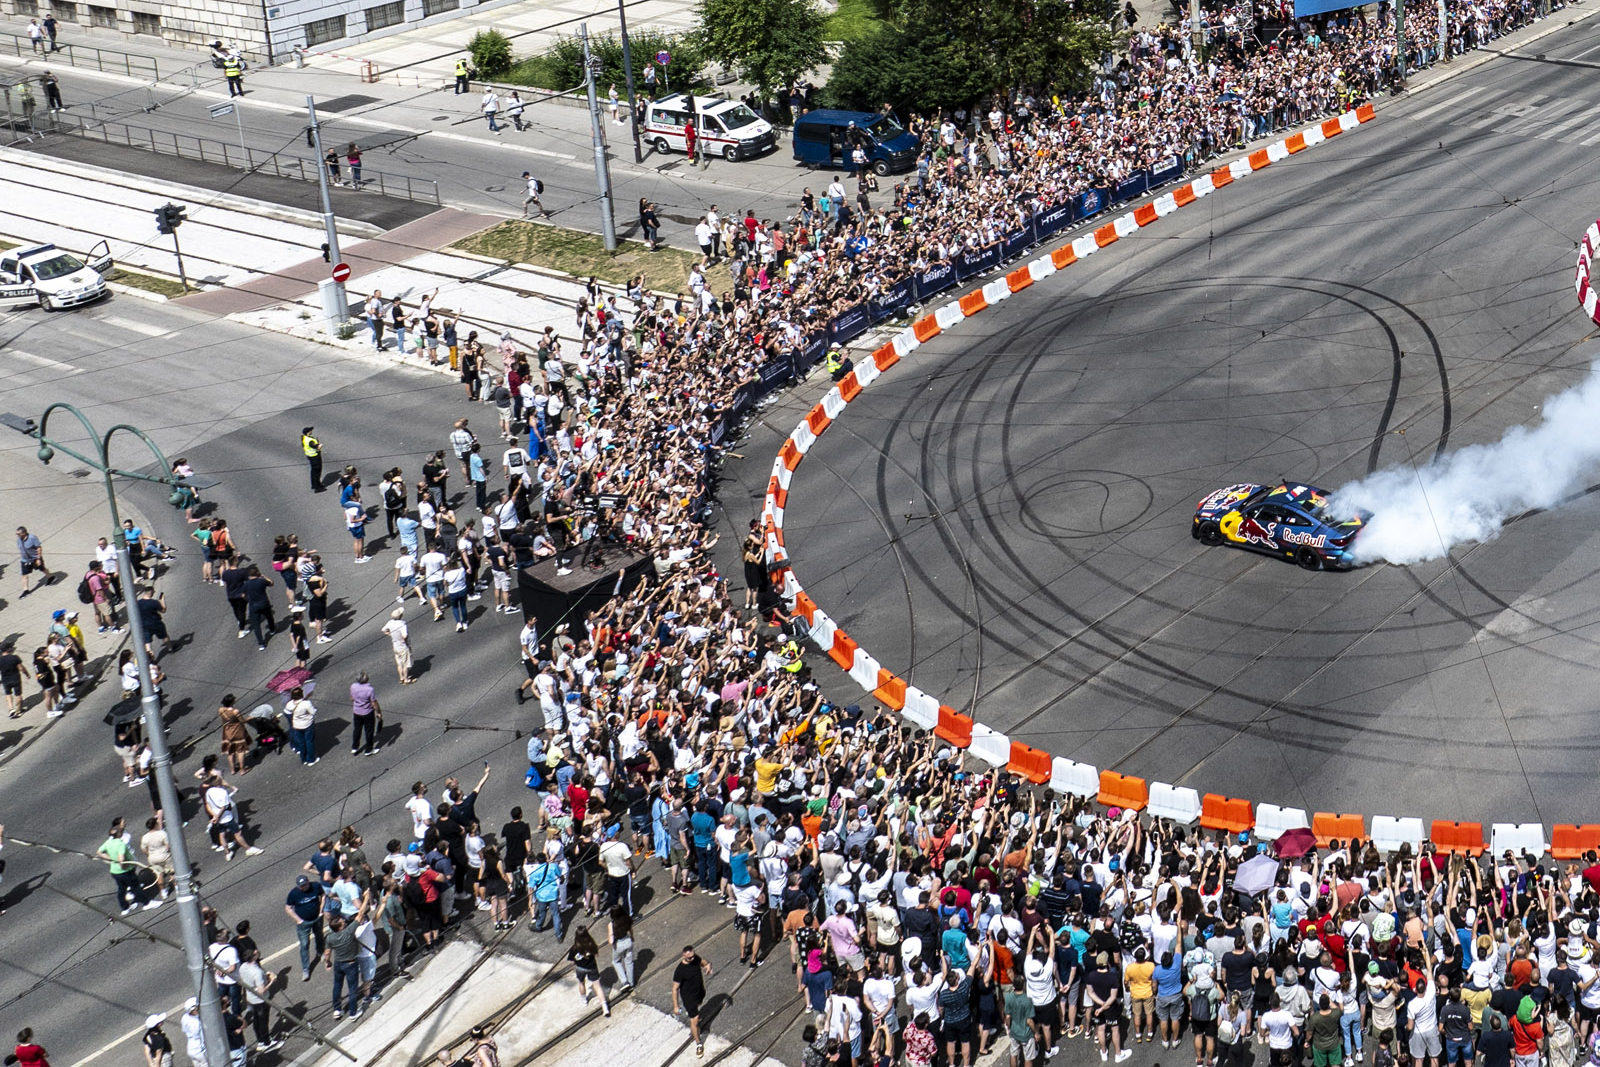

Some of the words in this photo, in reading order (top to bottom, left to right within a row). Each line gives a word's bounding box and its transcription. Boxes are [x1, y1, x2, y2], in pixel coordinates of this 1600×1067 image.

[1041, 208, 1066, 226] HTEC
[929, 266, 951, 280] Bingo
[1283, 527, 1303, 544] Red
[1302, 532, 1326, 548] Bull
